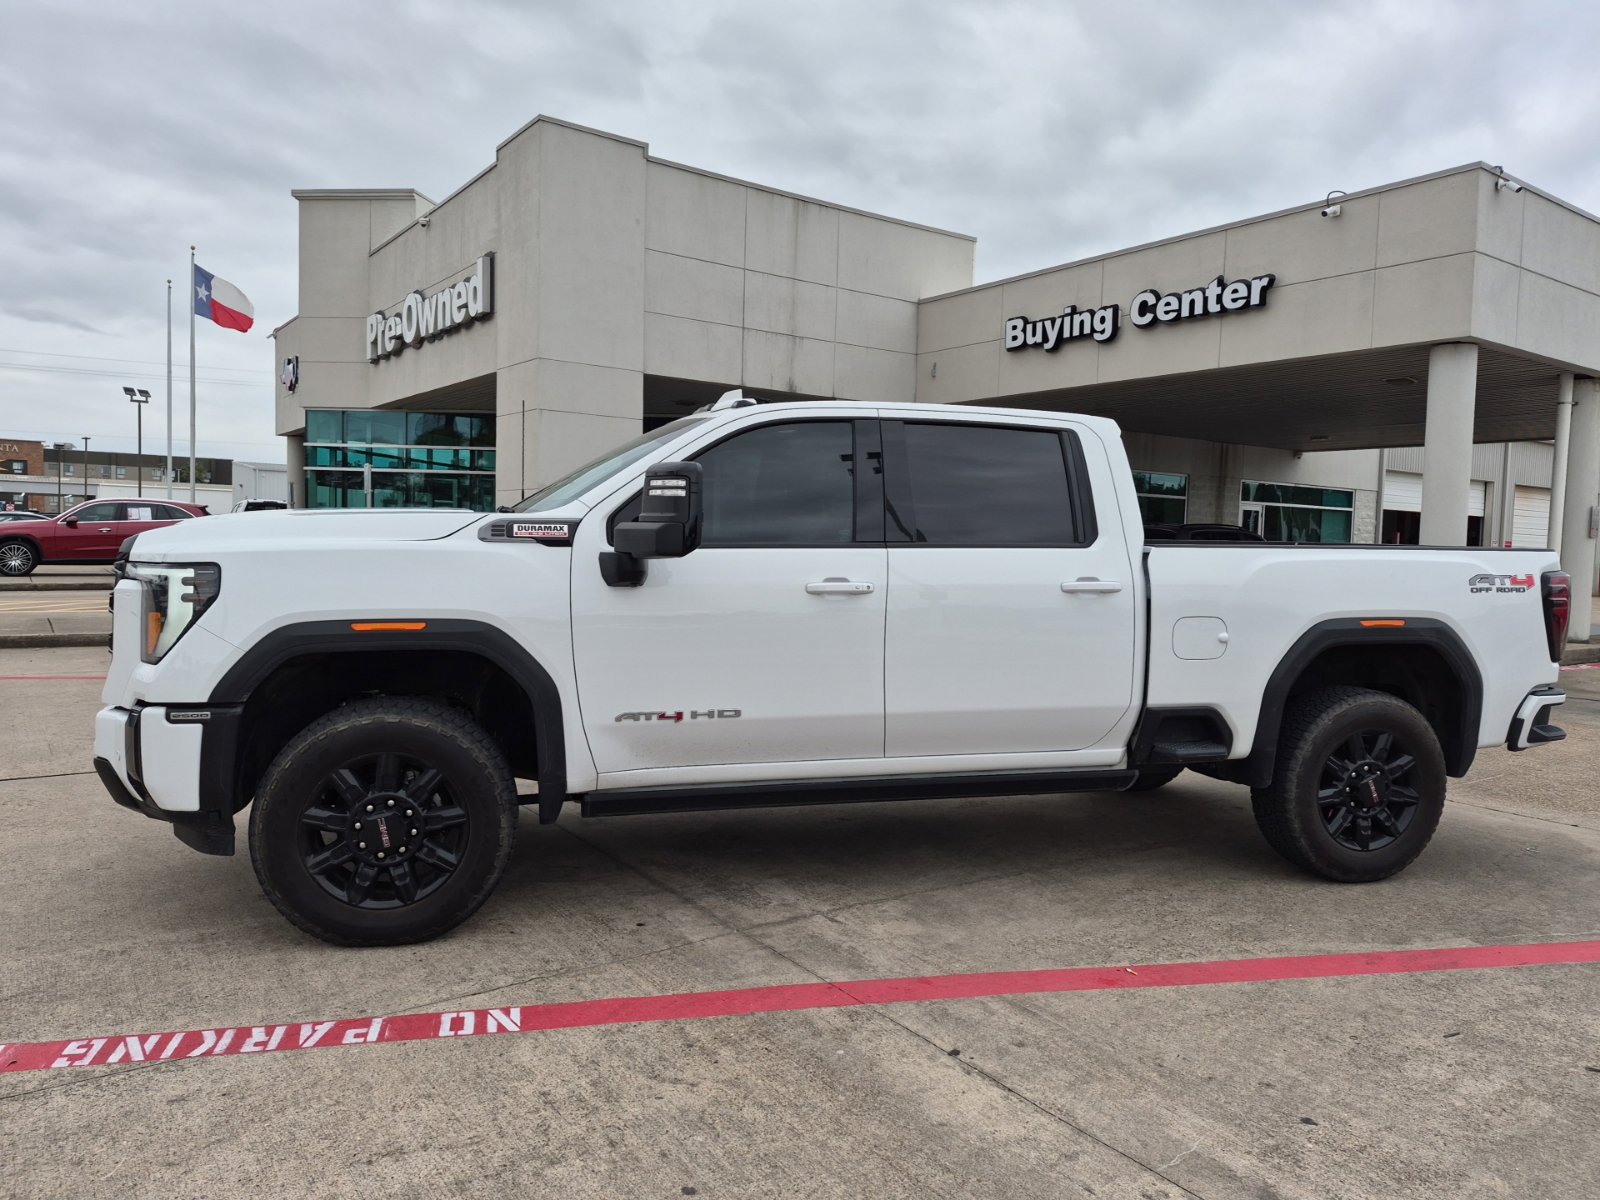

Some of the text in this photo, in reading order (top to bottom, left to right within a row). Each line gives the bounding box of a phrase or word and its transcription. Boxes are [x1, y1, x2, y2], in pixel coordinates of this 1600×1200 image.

[1005, 275, 1273, 351] Buying Center
[517, 524, 565, 532] DURAMAX
[1469, 573, 1535, 590] AT4
[614, 709, 742, 723] AT4 HD
[51, 1007, 521, 1068] NO PARKING
